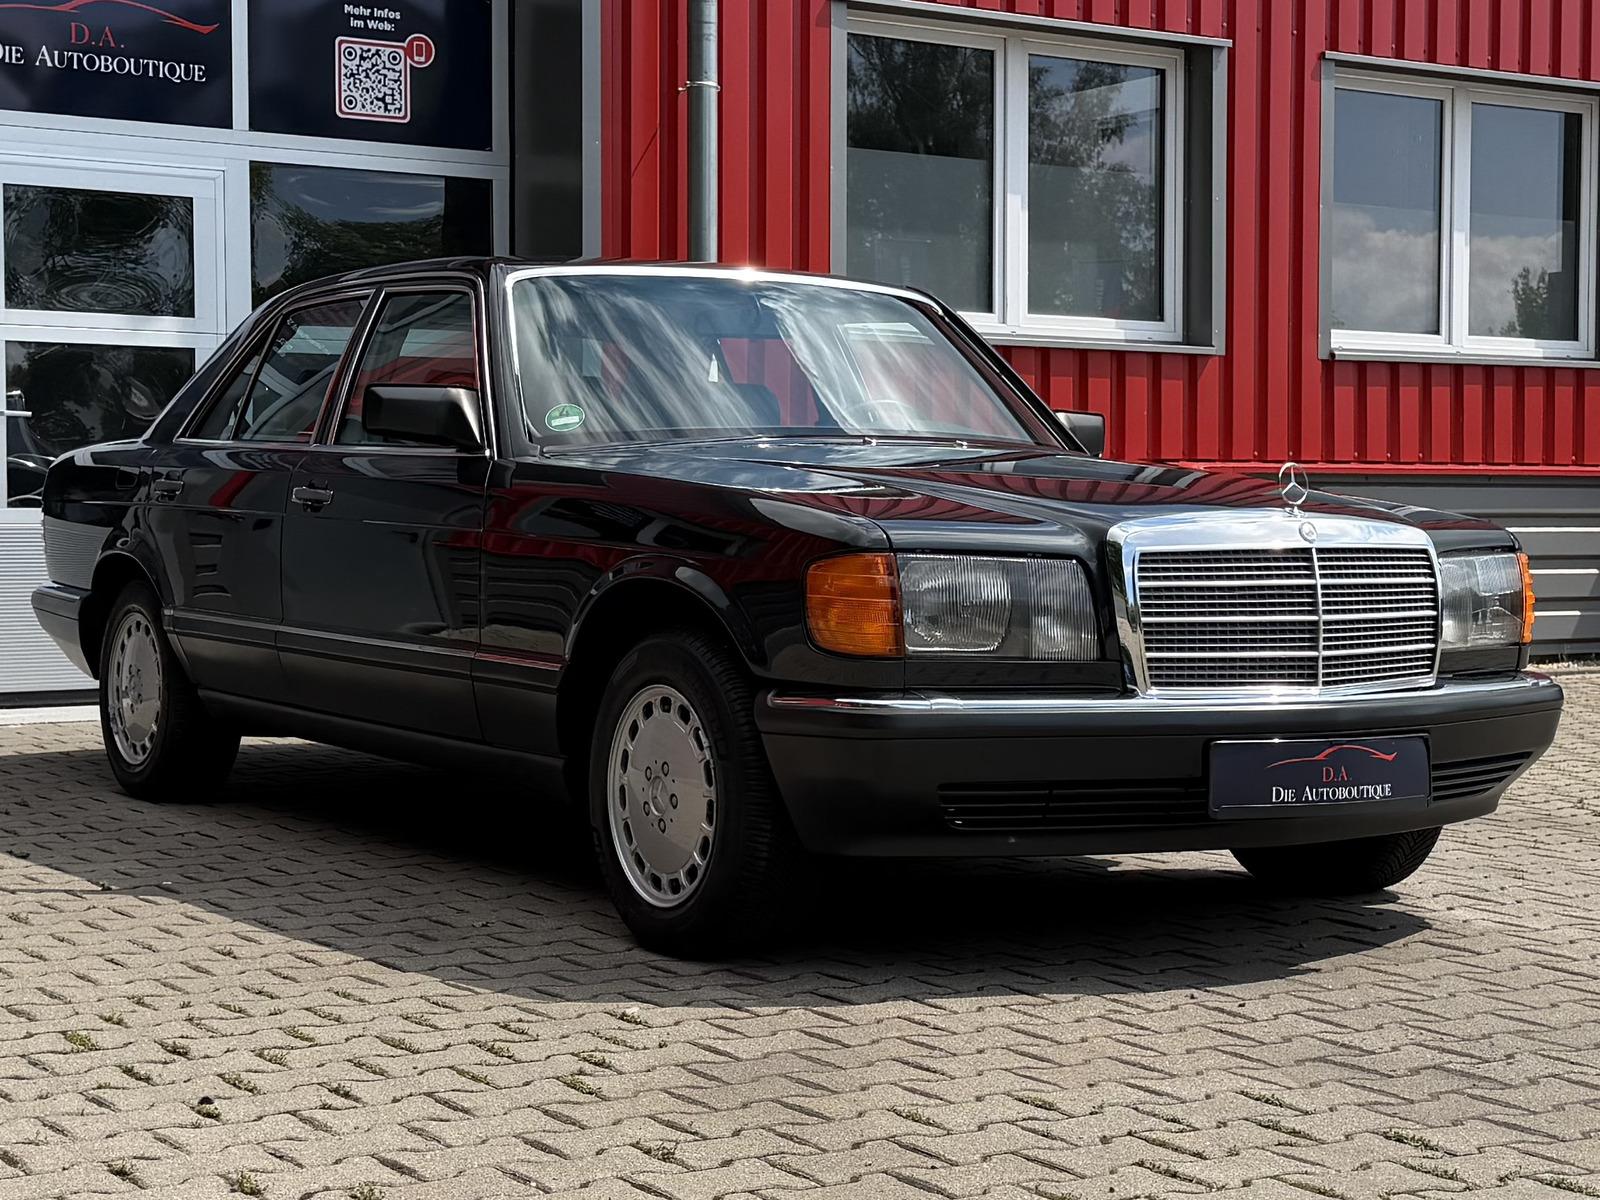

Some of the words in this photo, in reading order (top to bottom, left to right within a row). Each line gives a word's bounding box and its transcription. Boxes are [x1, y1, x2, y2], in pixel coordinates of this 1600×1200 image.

[344, 4, 371, 16] Mehr
[373, 8, 401, 20] Infos
[70, 22, 124, 48] D.A.
[366, 19, 395, 31] Web:
[0, 43, 25, 65] IE
[35, 45, 206, 82] AUTOBOUTIQUE
[1271, 786, 1297, 804] DIE
[1303, 783, 1392, 803] AUTOBOUTIQUE
